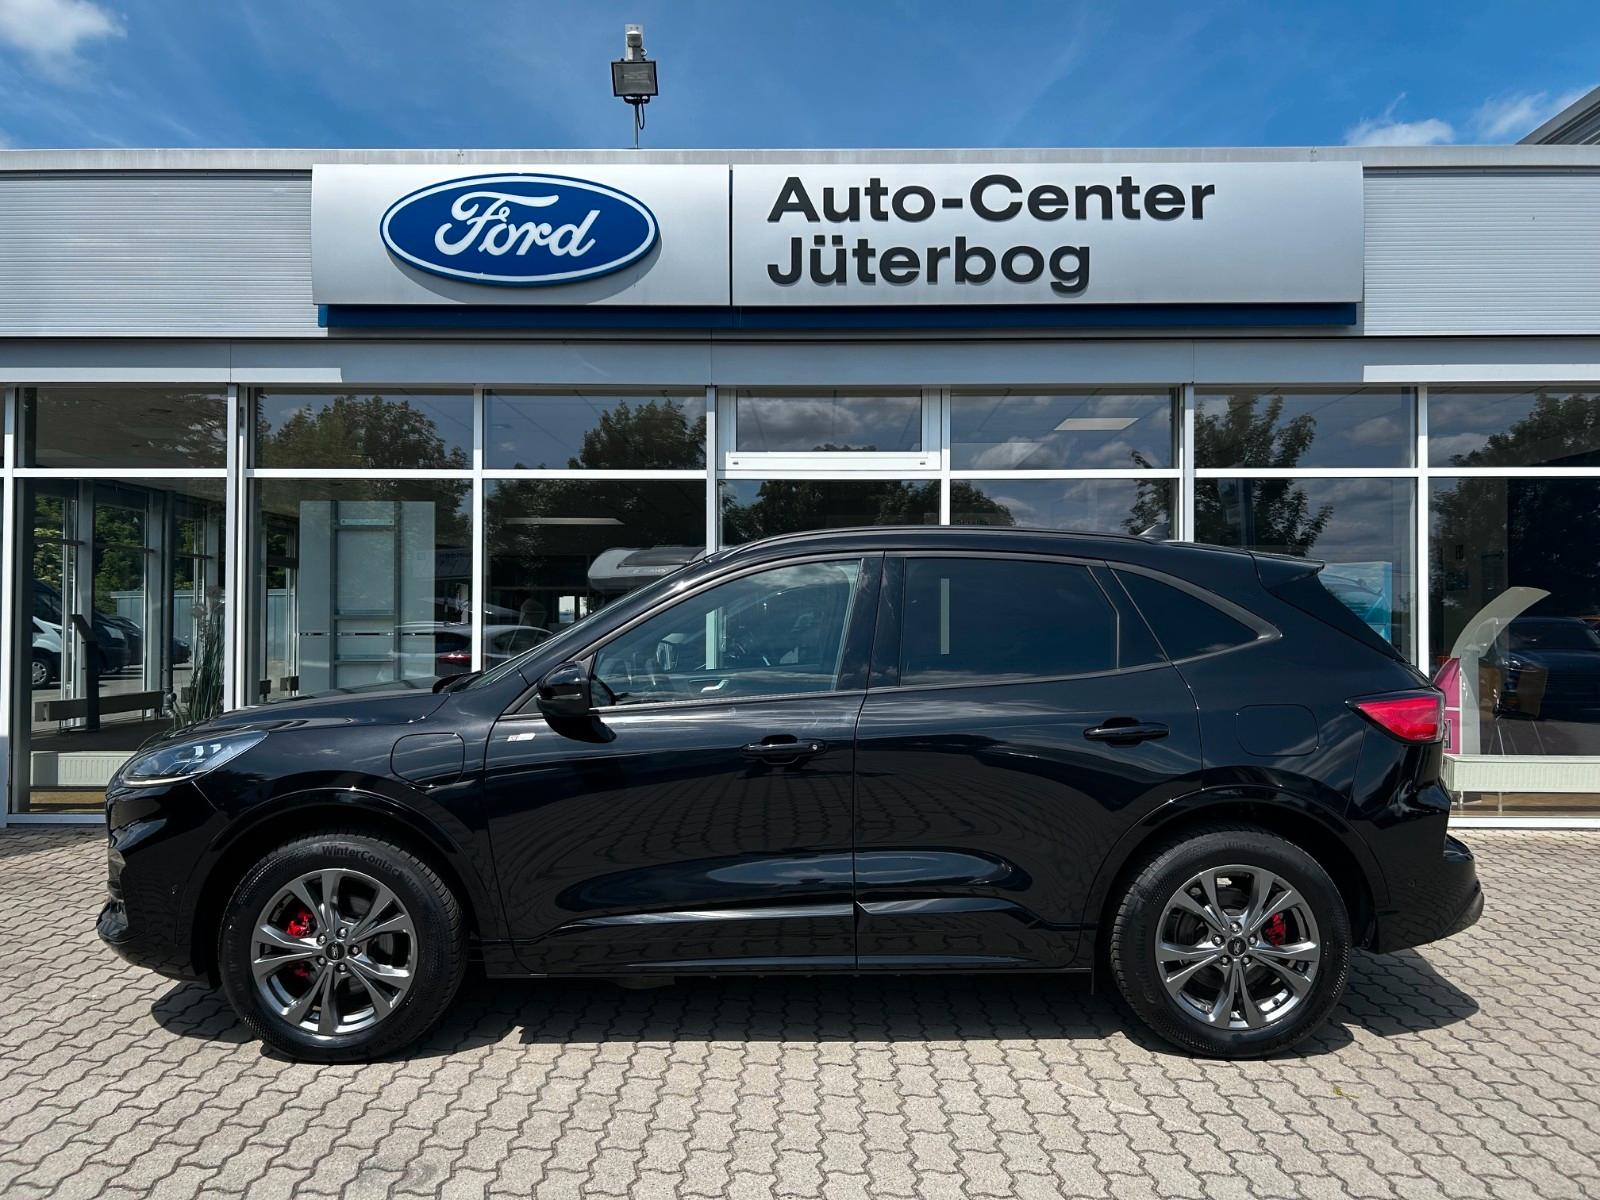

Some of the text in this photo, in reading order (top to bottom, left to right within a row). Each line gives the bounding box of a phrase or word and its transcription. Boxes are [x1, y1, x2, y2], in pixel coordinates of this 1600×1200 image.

[434, 191, 600, 257] Ford
[767, 174, 1215, 222] Auto-Center
[767, 235, 1090, 294] Jüterbog
